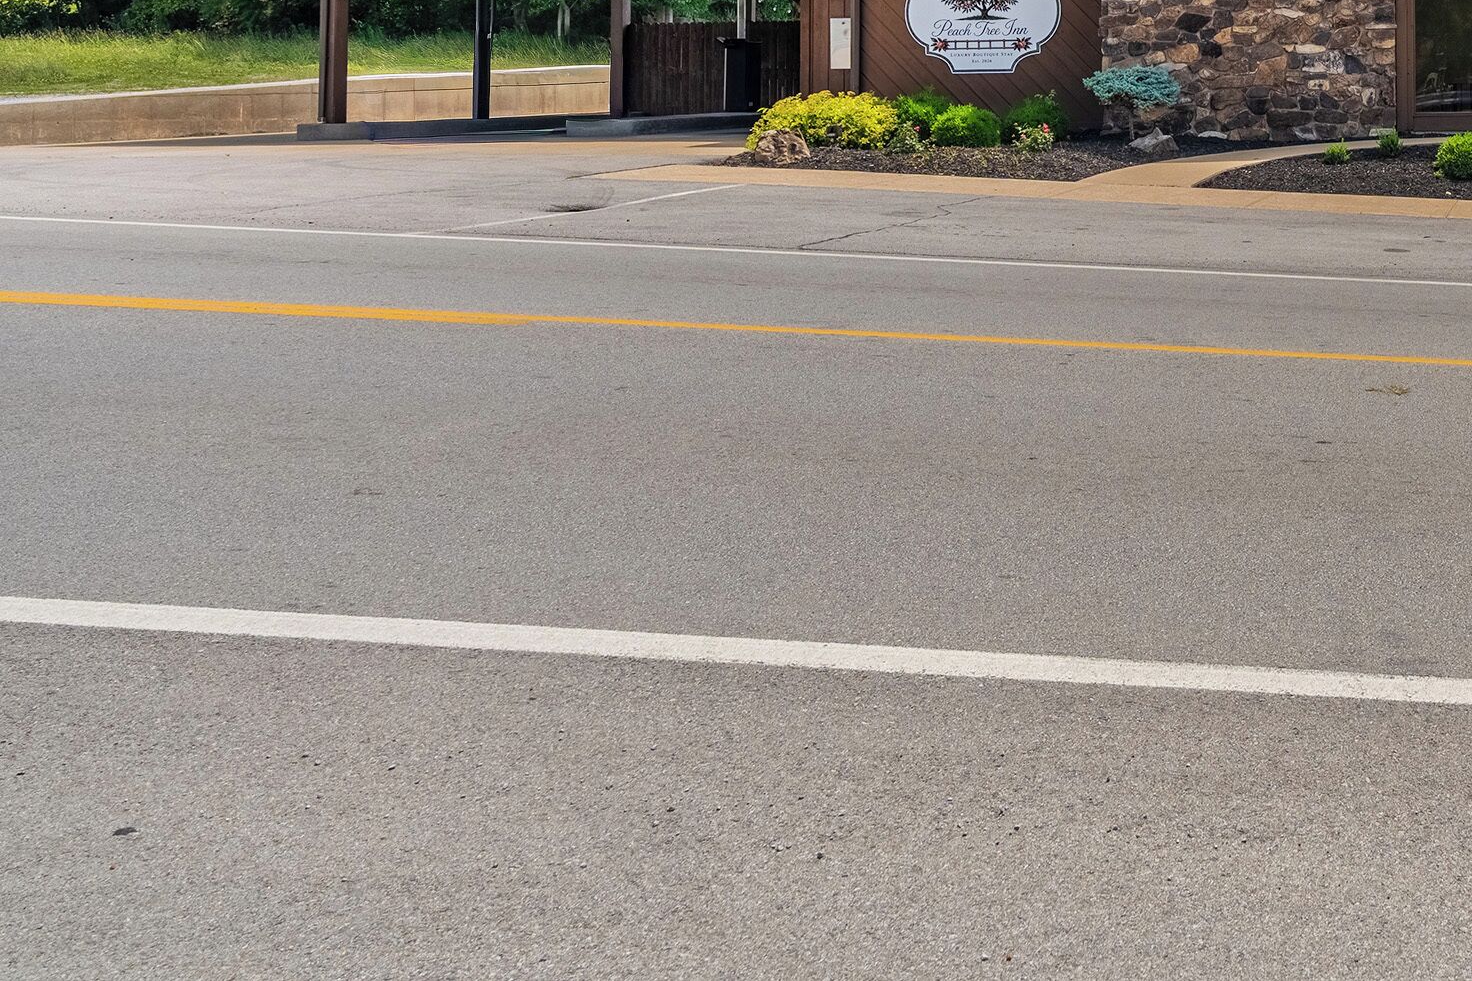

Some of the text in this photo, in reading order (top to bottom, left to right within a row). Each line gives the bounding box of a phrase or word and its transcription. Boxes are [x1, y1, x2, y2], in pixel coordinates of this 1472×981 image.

[931, 18, 1029, 37] Peach Tree Inn
